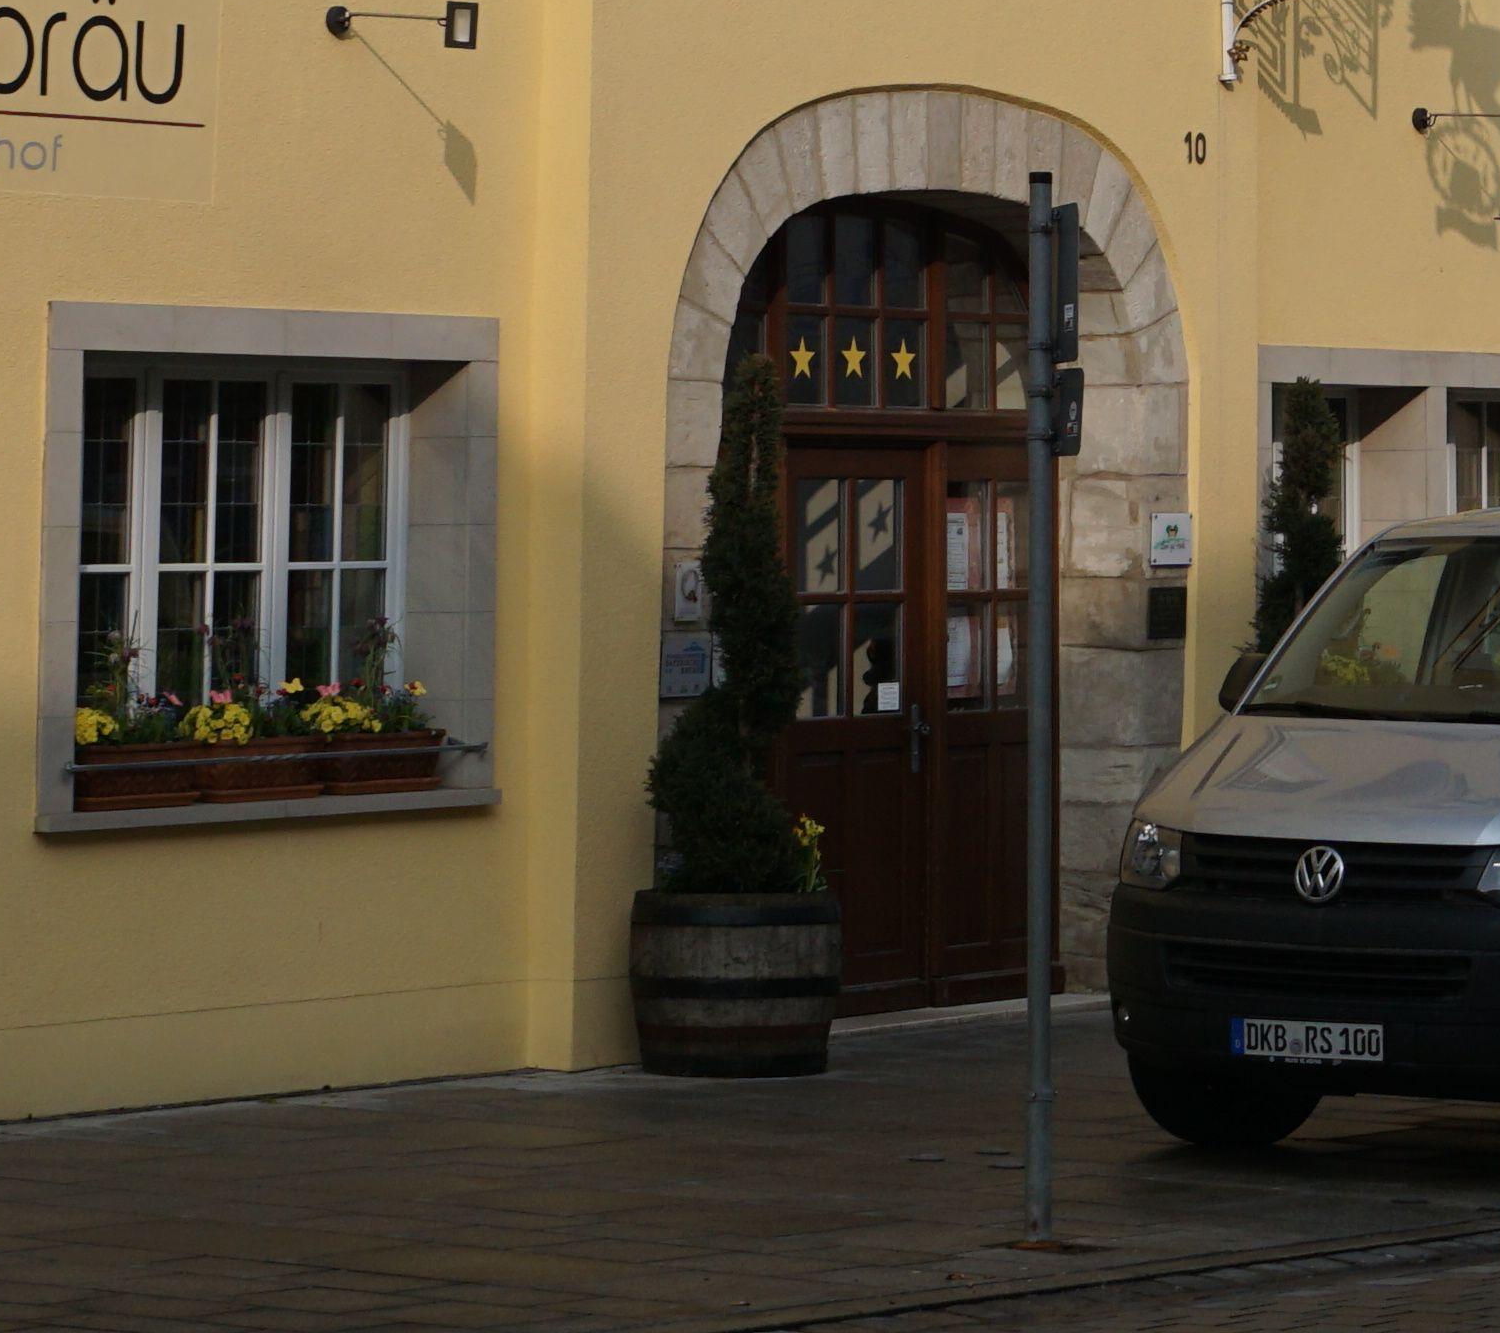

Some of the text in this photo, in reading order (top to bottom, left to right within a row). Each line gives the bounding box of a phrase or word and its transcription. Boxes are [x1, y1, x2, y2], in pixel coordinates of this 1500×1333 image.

[1183, 131, 1208, 165] 10
[1245, 1022, 1287, 1052] DKB
[1304, 1026, 1333, 1055] RS
[1338, 1027, 1381, 1057] 100
